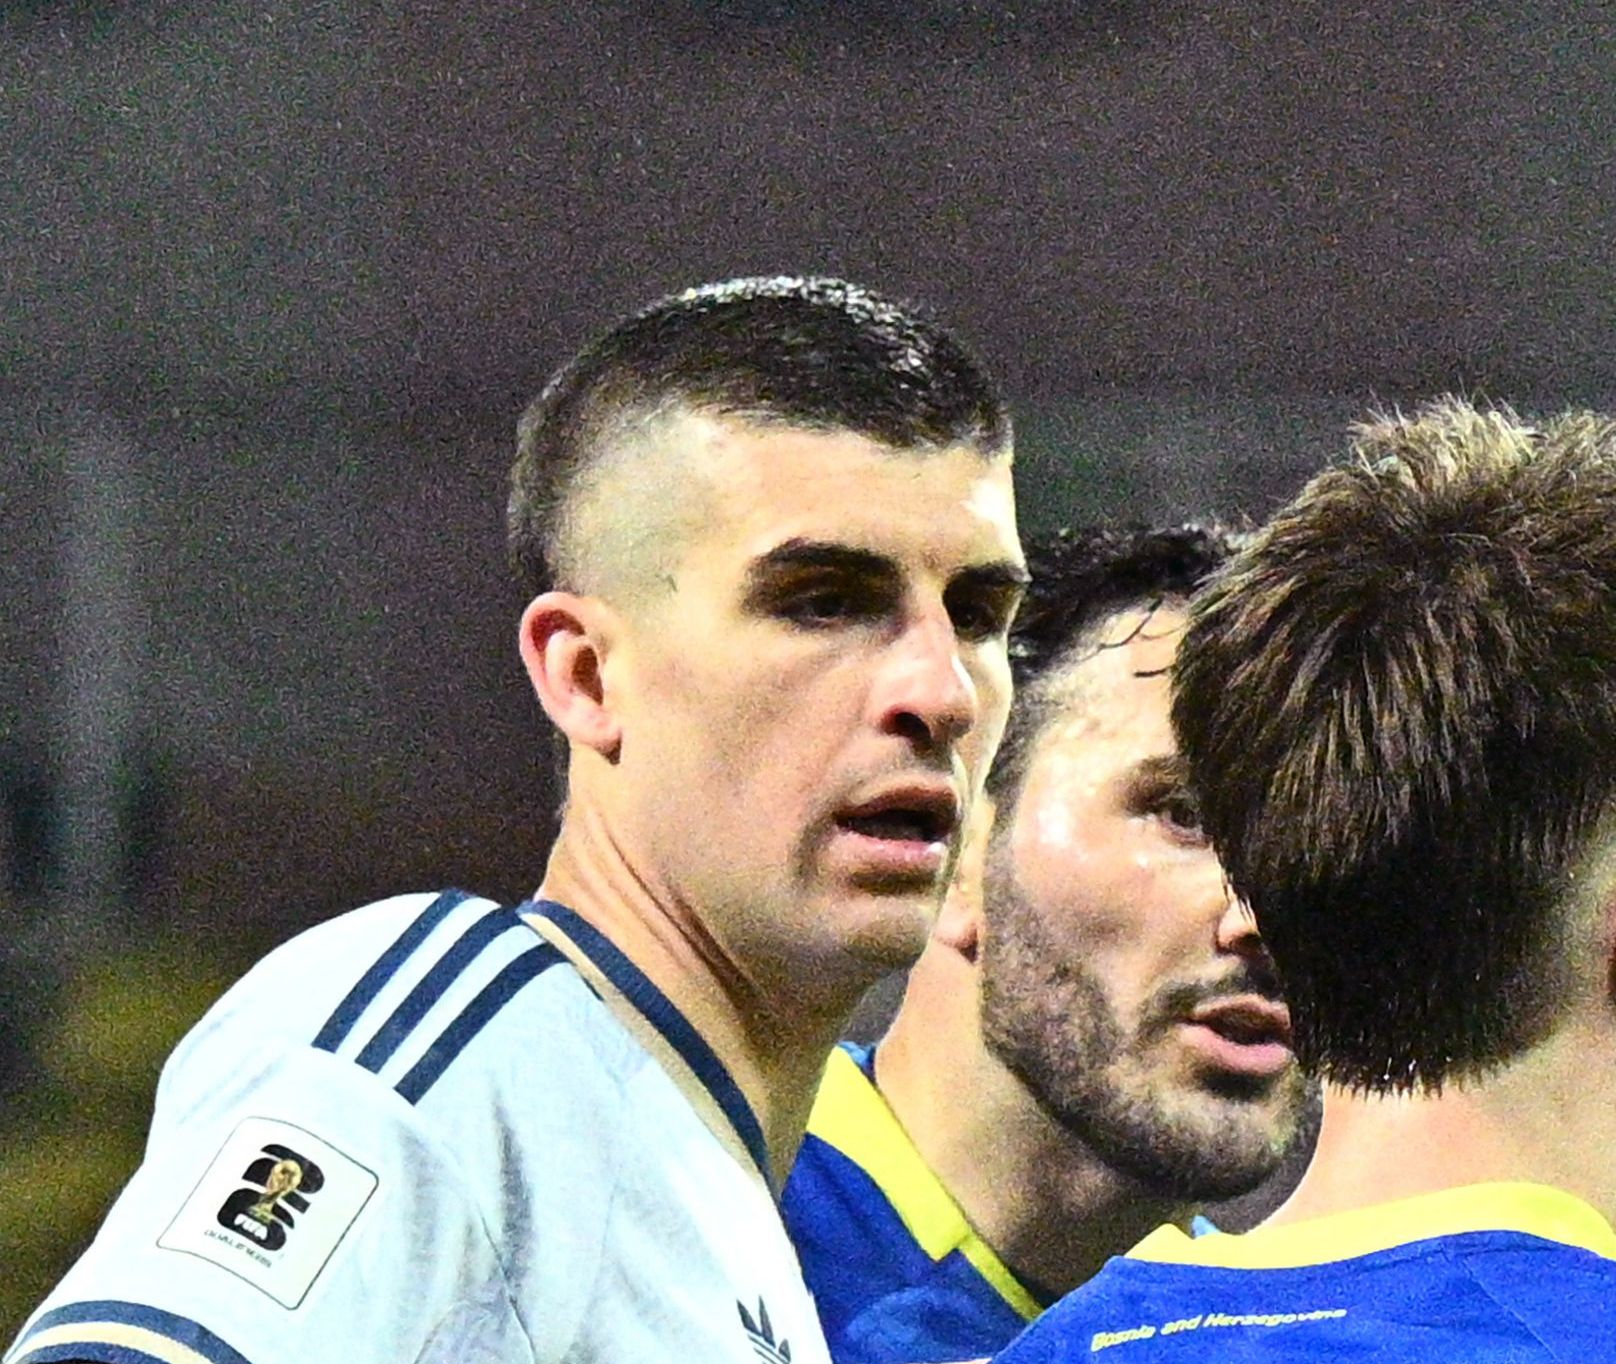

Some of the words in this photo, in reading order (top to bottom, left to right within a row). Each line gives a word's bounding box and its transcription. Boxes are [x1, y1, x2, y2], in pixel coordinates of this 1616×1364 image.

[1091, 1324, 1156, 1353] Bosnia
[1160, 1314, 1202, 1335] and
[1202, 1308, 1348, 1328] Herzegovina
